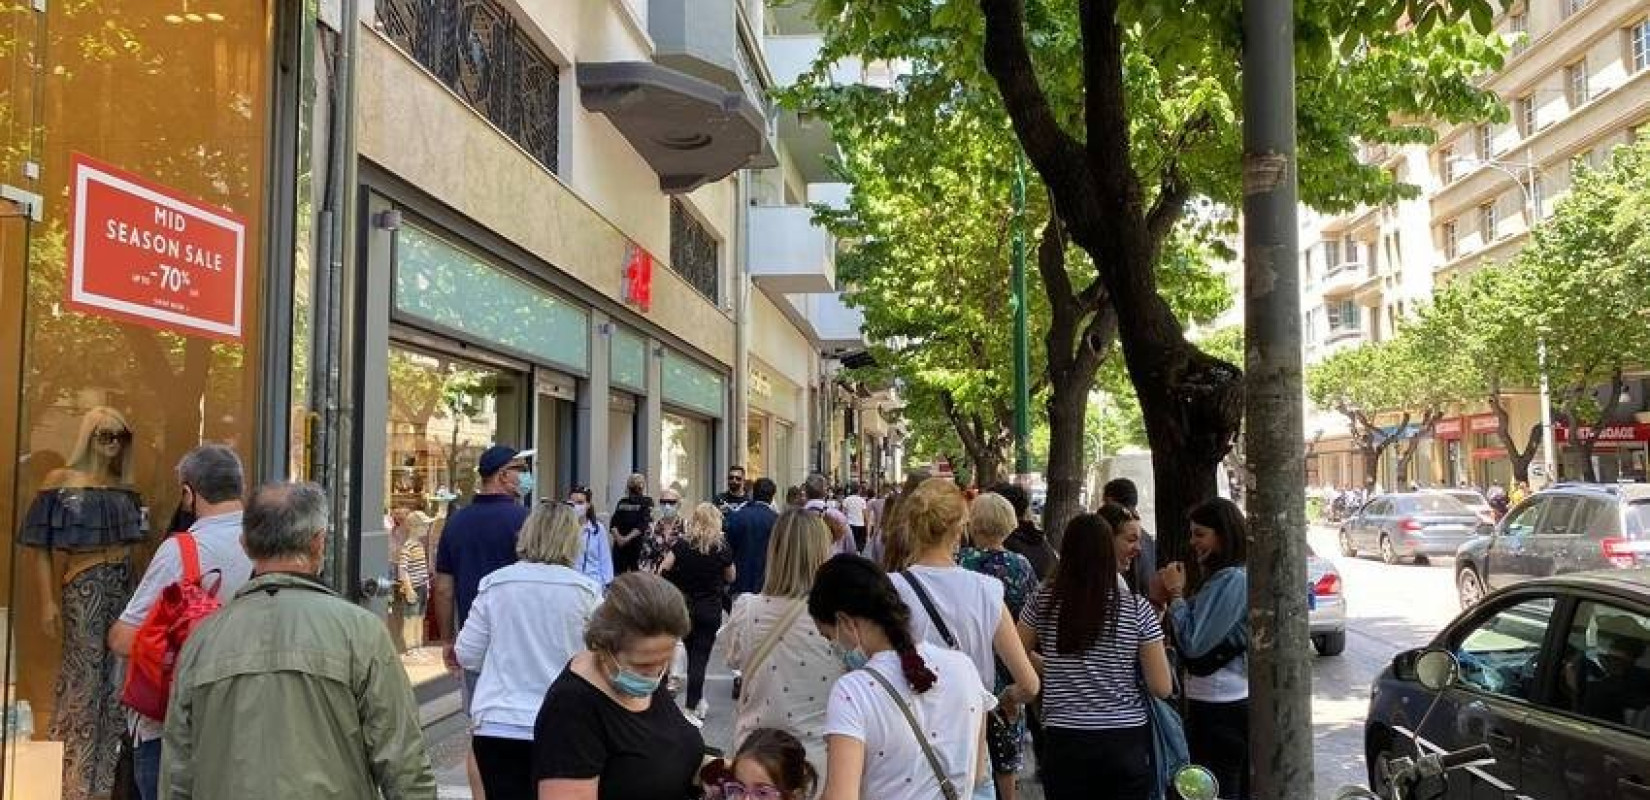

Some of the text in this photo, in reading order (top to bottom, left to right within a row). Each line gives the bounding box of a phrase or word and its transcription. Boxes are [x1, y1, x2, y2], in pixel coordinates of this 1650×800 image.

[154, 206, 186, 232] MID
[106, 218, 222, 271] SEASON SALE
